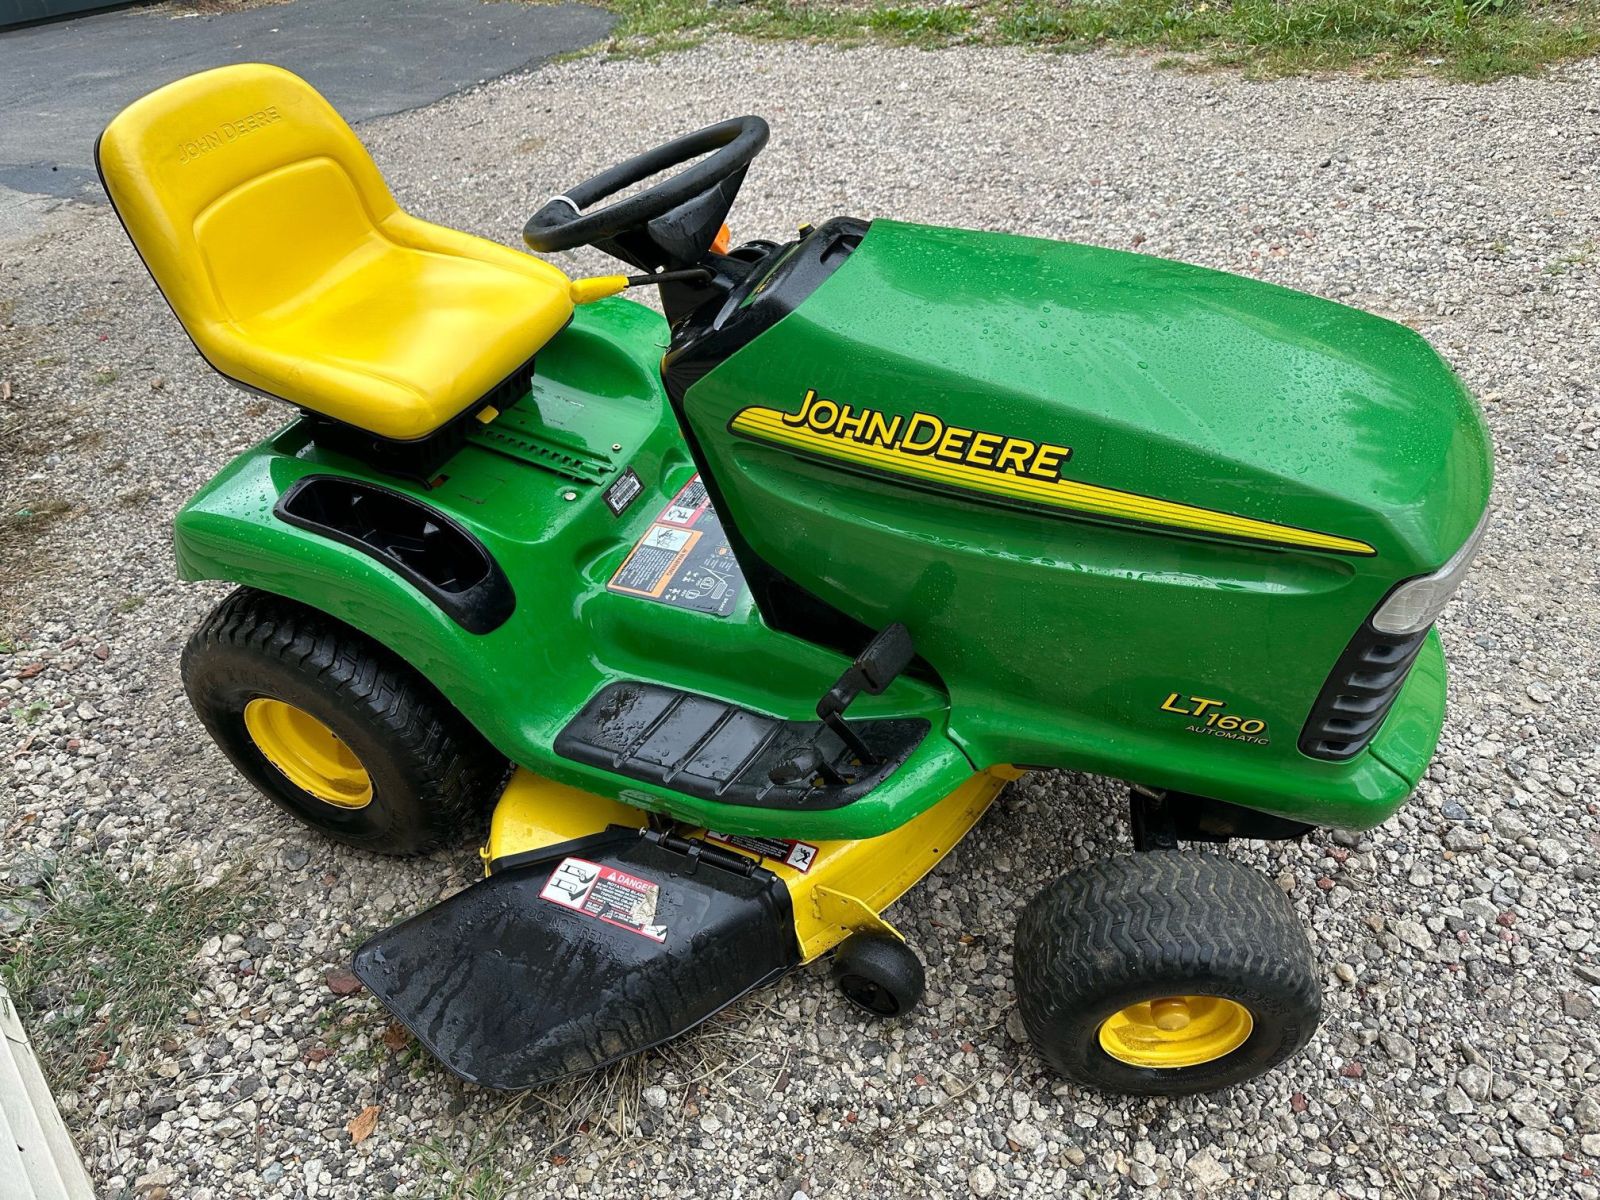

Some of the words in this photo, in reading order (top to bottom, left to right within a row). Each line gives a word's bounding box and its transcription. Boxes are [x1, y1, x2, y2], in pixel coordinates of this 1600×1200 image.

[178, 131, 223, 165] JOHN
[219, 105, 281, 142] DEERE
[782, 389, 903, 446] JOHN
[900, 411, 1072, 482] DEERE
[1185, 724, 1270, 745] AUTOMATIC
[549, 916, 577, 933] NOT
